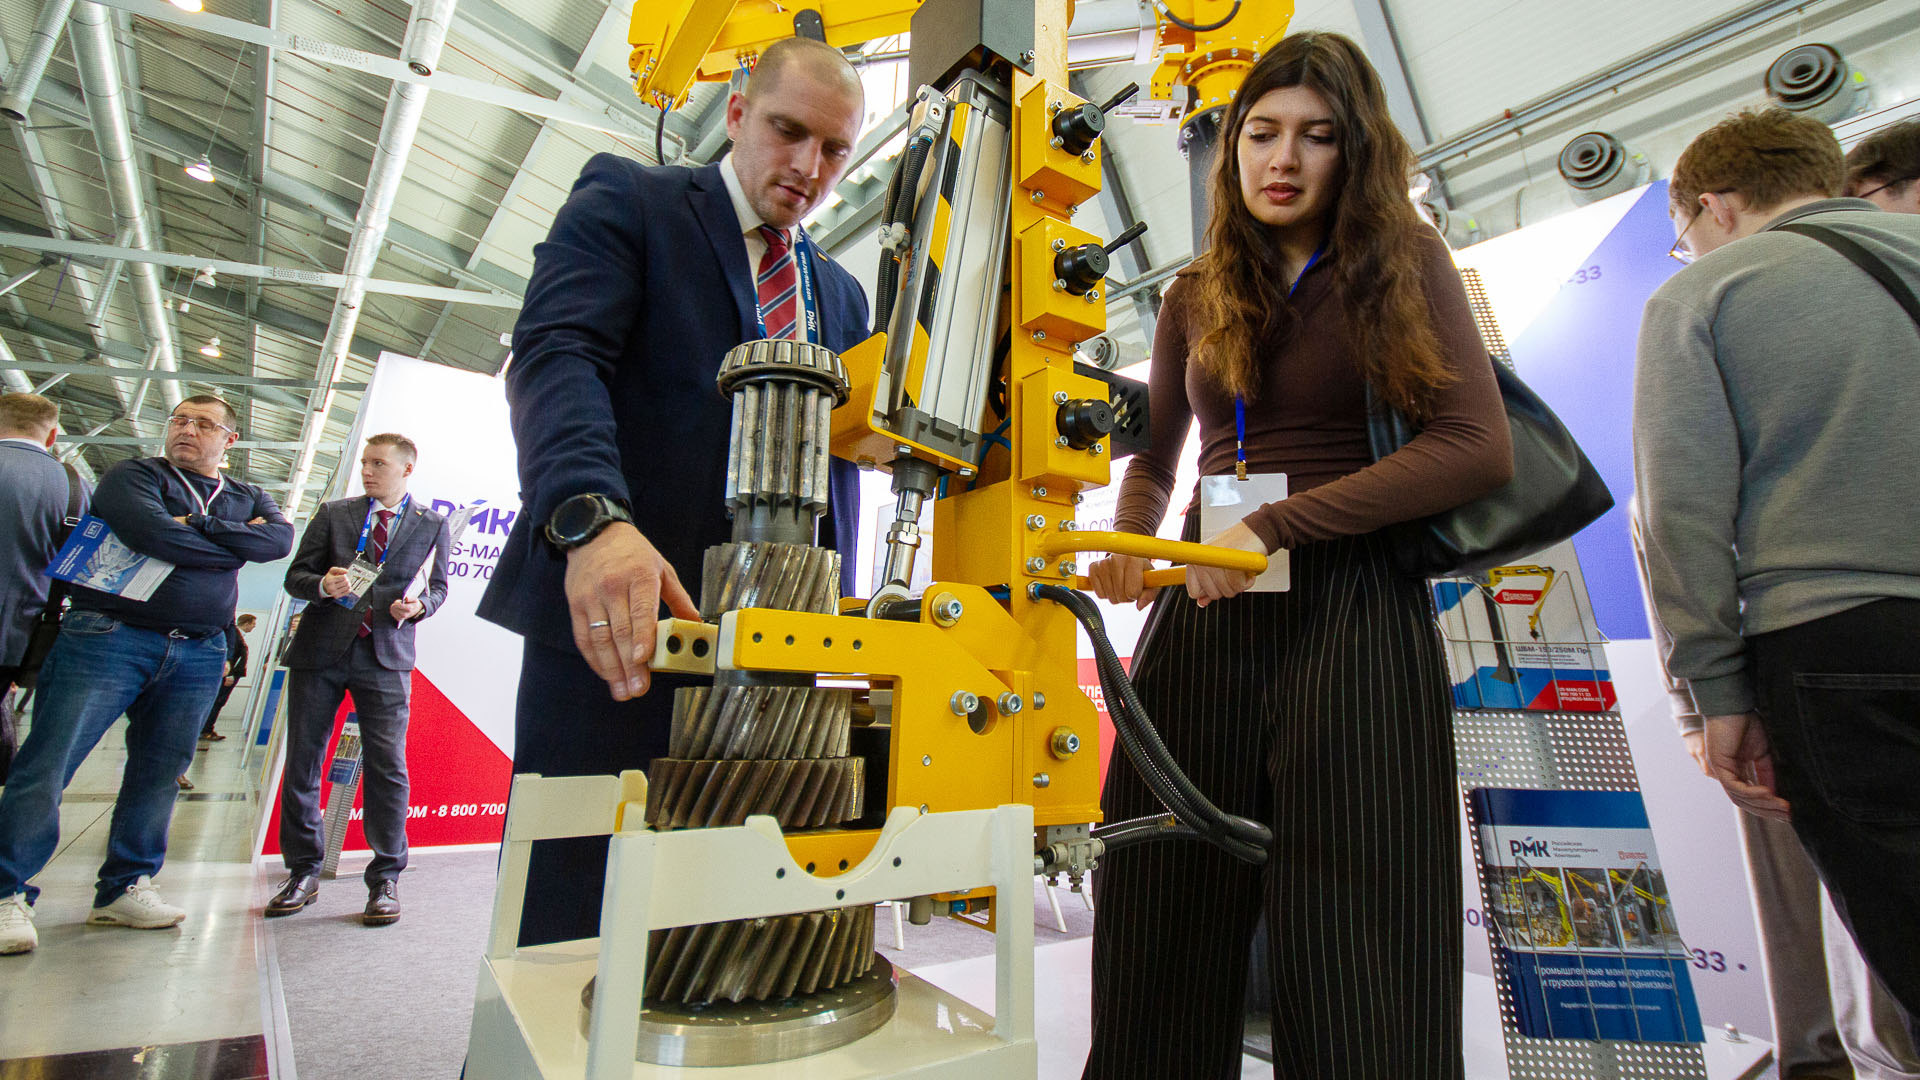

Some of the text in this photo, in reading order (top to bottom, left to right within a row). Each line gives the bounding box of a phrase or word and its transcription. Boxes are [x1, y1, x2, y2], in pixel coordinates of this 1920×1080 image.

[451, 804, 477, 817] 800
[480, 803, 506, 816] 700
[1509, 837, 1551, 857] РМК
[1549, 979, 1617, 990] грузозахатные
[1617, 980, 1673, 990] мханизмы
